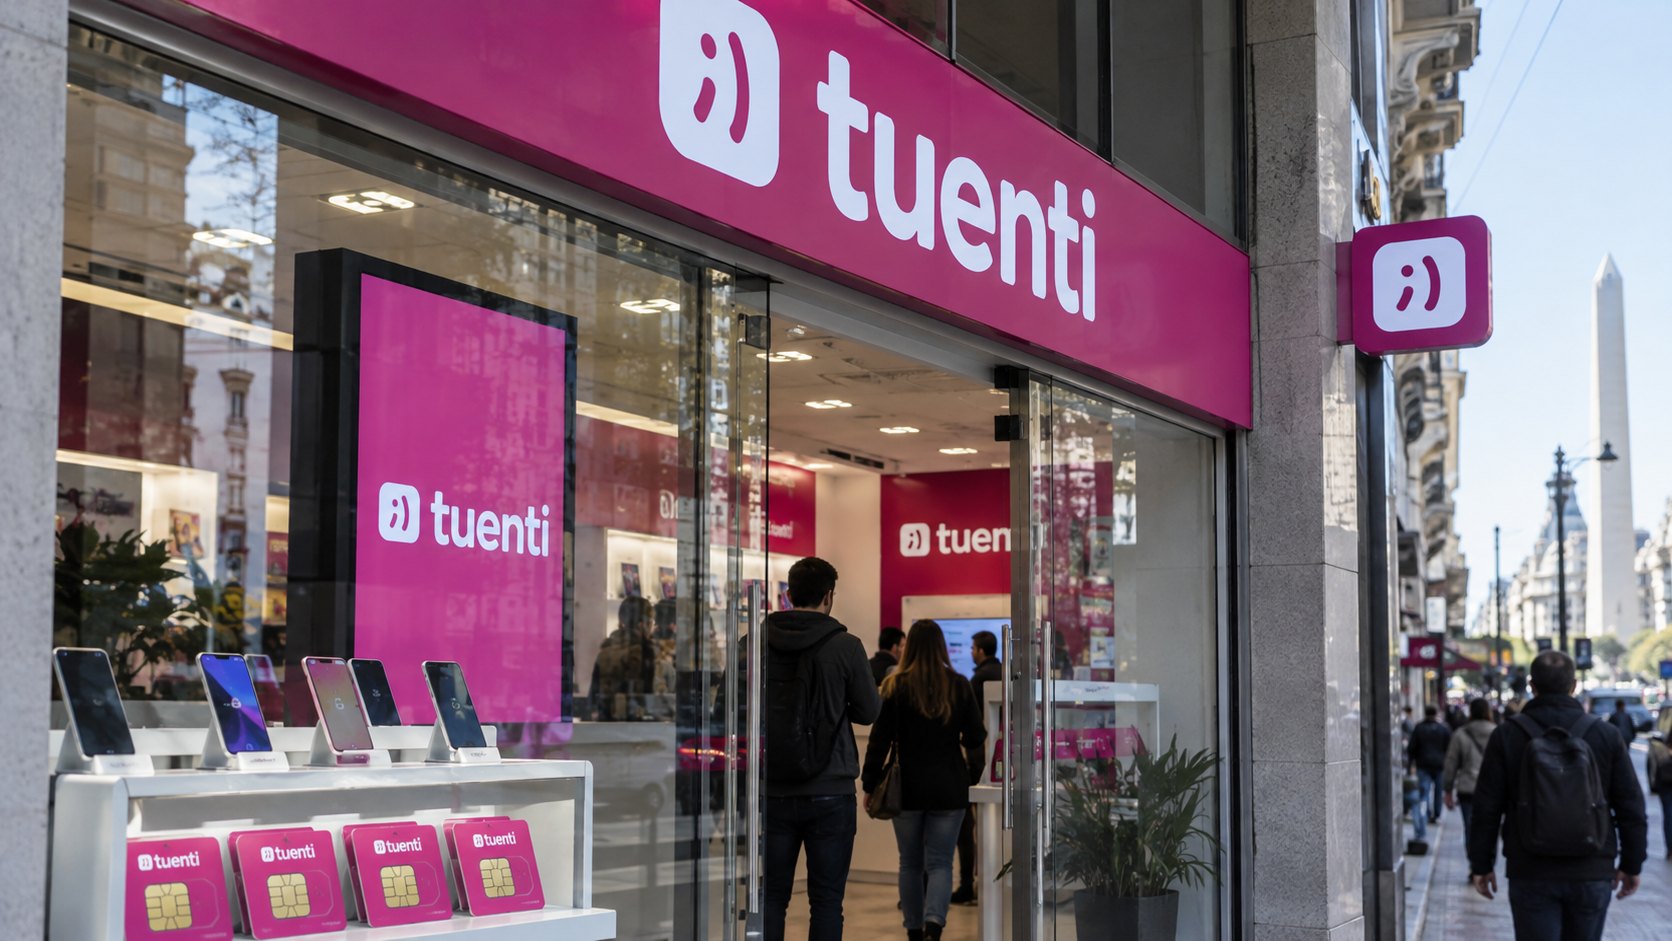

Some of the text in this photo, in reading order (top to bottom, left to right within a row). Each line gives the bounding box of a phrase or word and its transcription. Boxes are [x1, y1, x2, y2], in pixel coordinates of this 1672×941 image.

[817, 50, 1096, 322] tuenti
[430, 491, 550, 557] tuenti
[936, 523, 1012, 554] tuen
[386, 837, 422, 853] tuenti
[483, 831, 517, 847] tuenti
[153, 851, 200, 869] tuenti
[274, 843, 316, 861] tuenti
